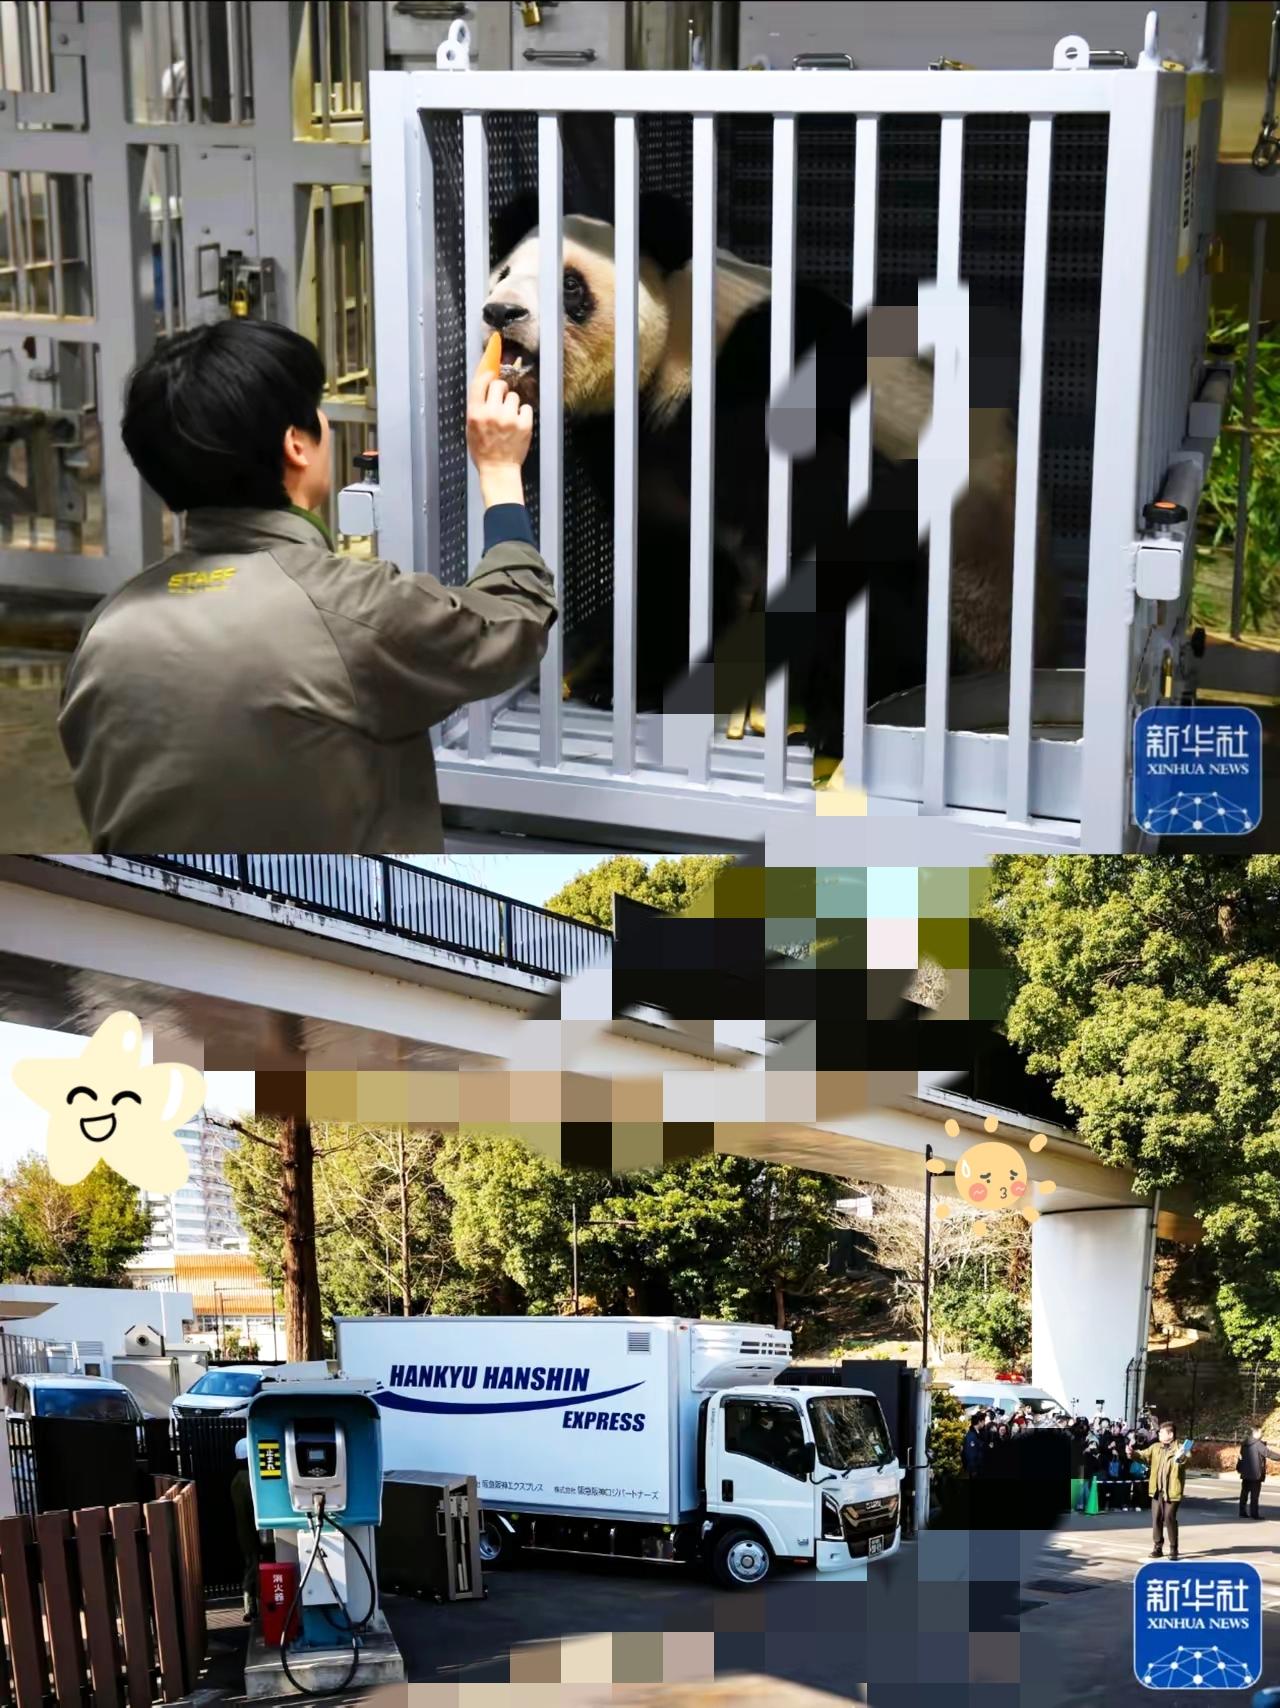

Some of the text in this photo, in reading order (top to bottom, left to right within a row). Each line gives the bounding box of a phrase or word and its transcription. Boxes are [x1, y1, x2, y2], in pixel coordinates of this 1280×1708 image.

[168, 567, 237, 587] STAFF
[389, 1364, 590, 1392] HANKYU HANSHIN
[562, 1410, 646, 1432] EXPRESS
